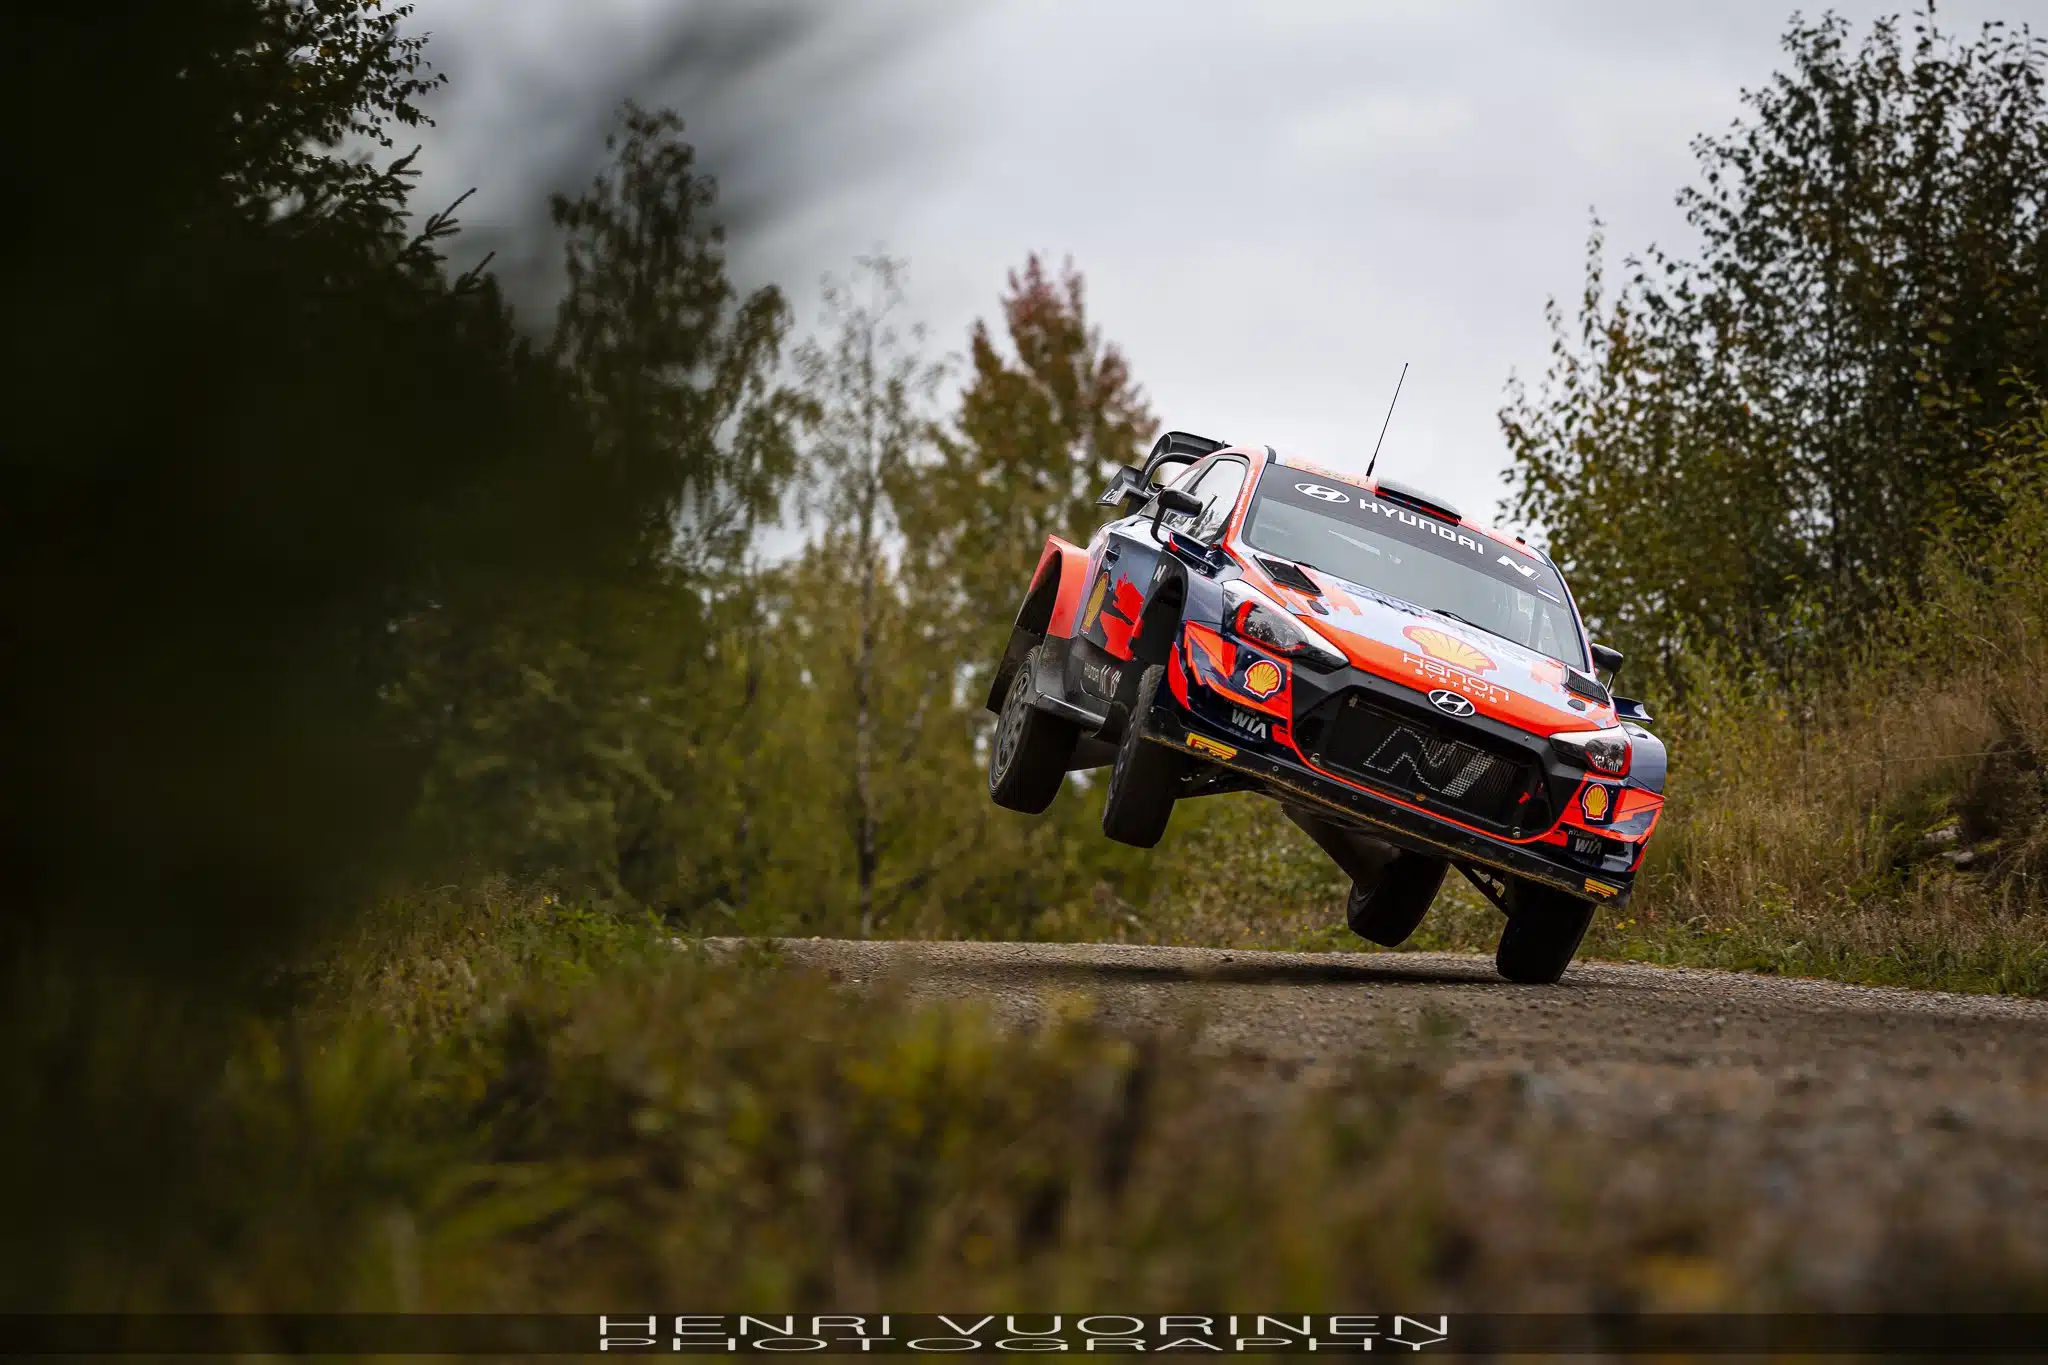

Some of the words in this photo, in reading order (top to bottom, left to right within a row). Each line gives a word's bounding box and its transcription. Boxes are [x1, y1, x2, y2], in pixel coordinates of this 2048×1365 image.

[1359, 498, 1484, 555] HYUNDAI
[1403, 653, 1510, 702] Hanon
[1415, 668, 1498, 703] SYSTEMS
